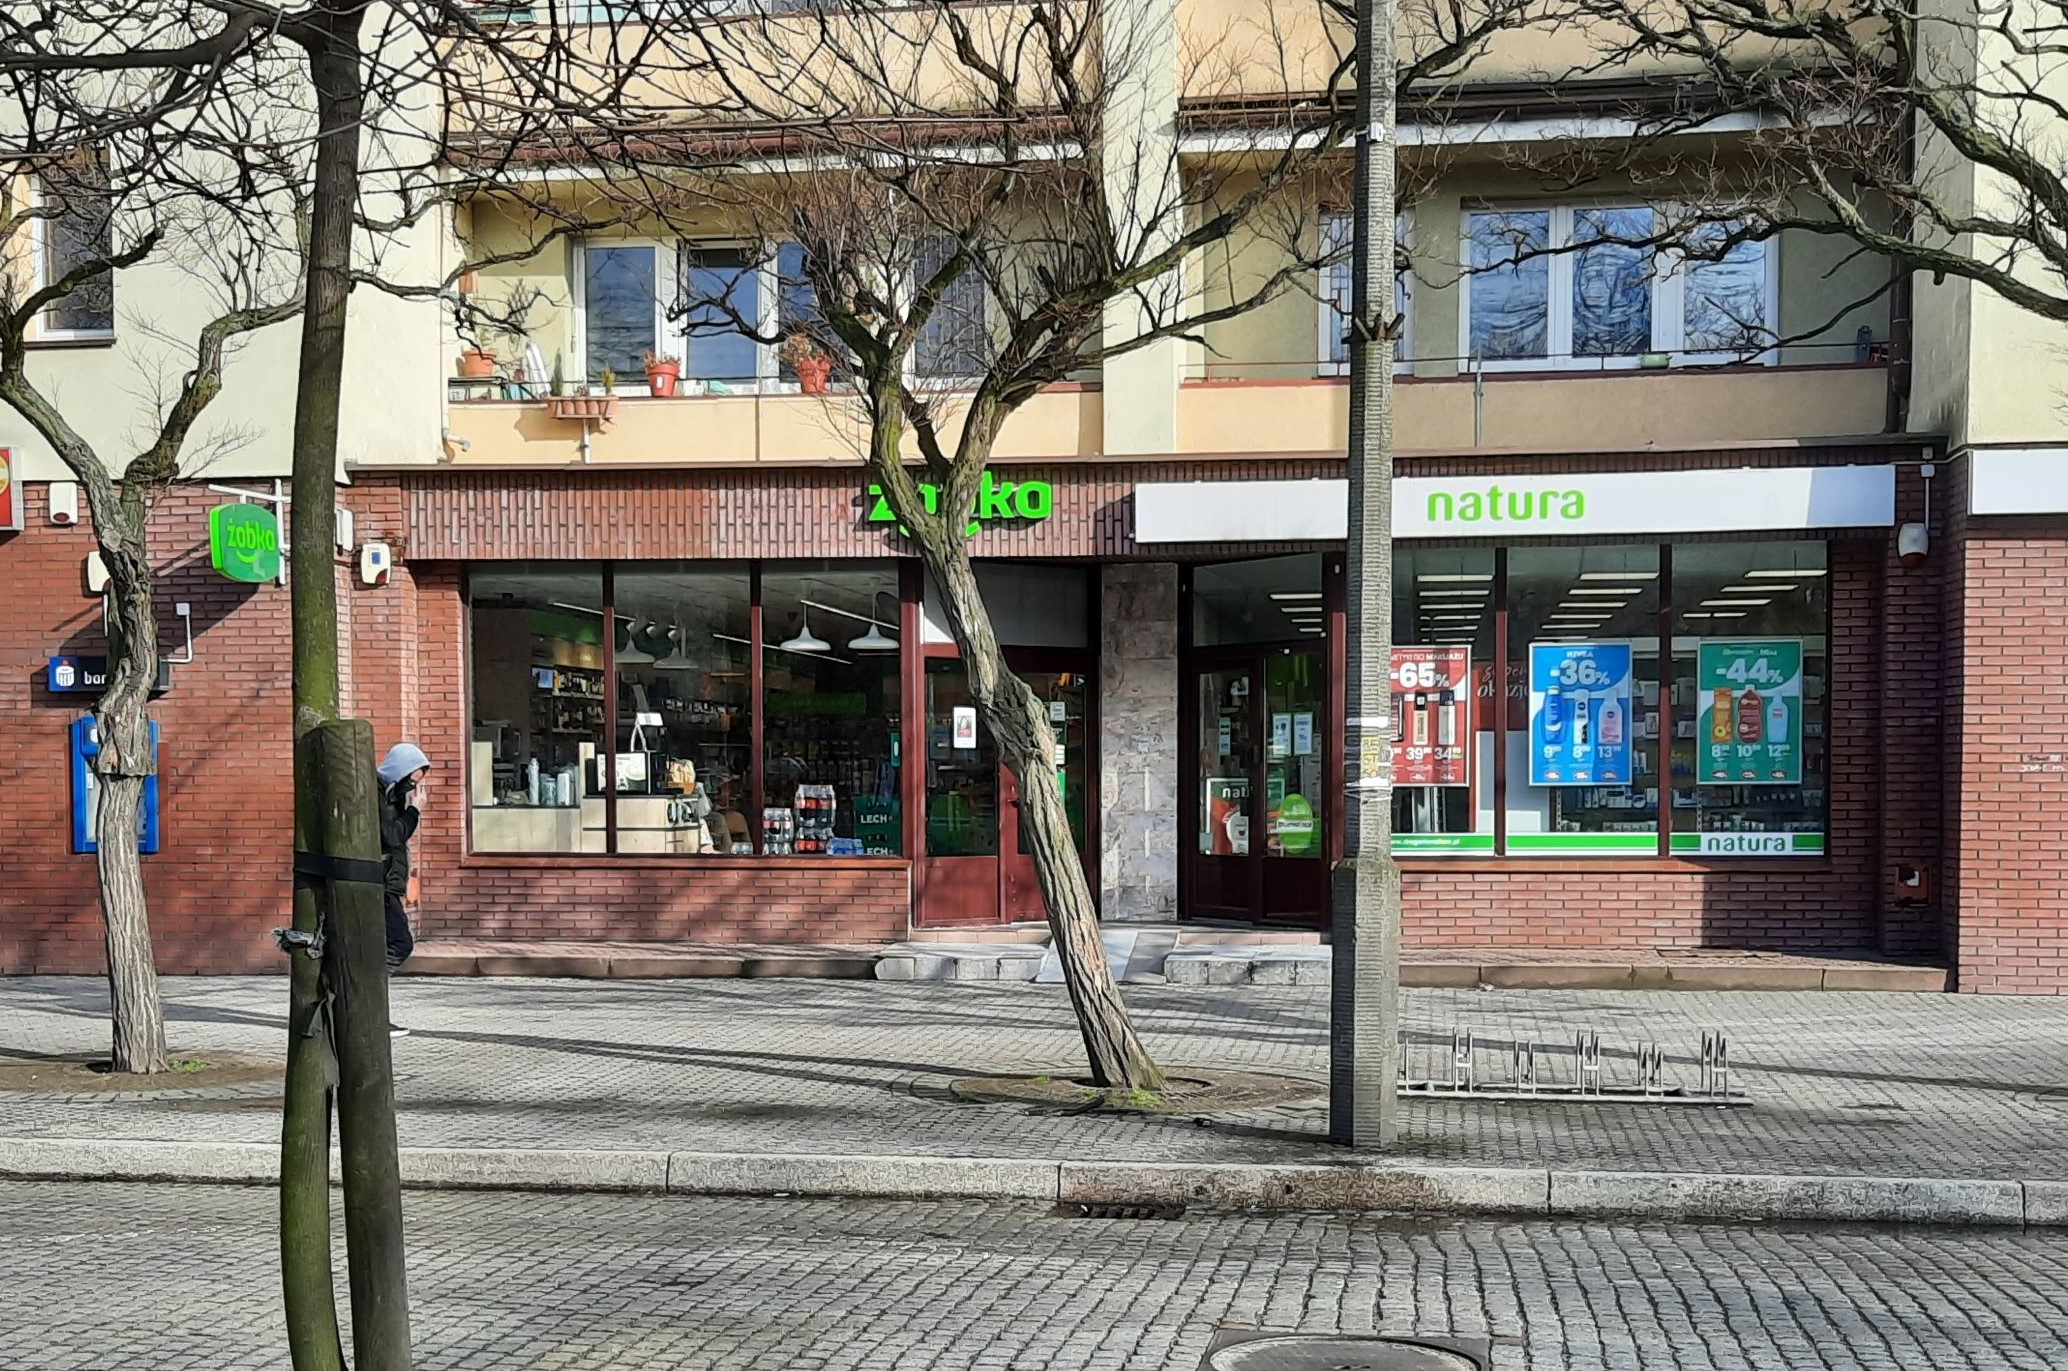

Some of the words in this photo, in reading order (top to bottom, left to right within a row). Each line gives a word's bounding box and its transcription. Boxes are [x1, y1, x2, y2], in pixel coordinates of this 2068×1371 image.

[1427, 484, 1585, 522] natura
[227, 517, 275, 551] żabka
[1390, 662, 1450, 688] -65%
[1551, 659, 1610, 685] -36%
[1716, 657, 1783, 683] -44%
[1477, 680, 1527, 699] okzj
[860, 814, 887, 824] LECH
[1708, 835, 1786, 852] natura
